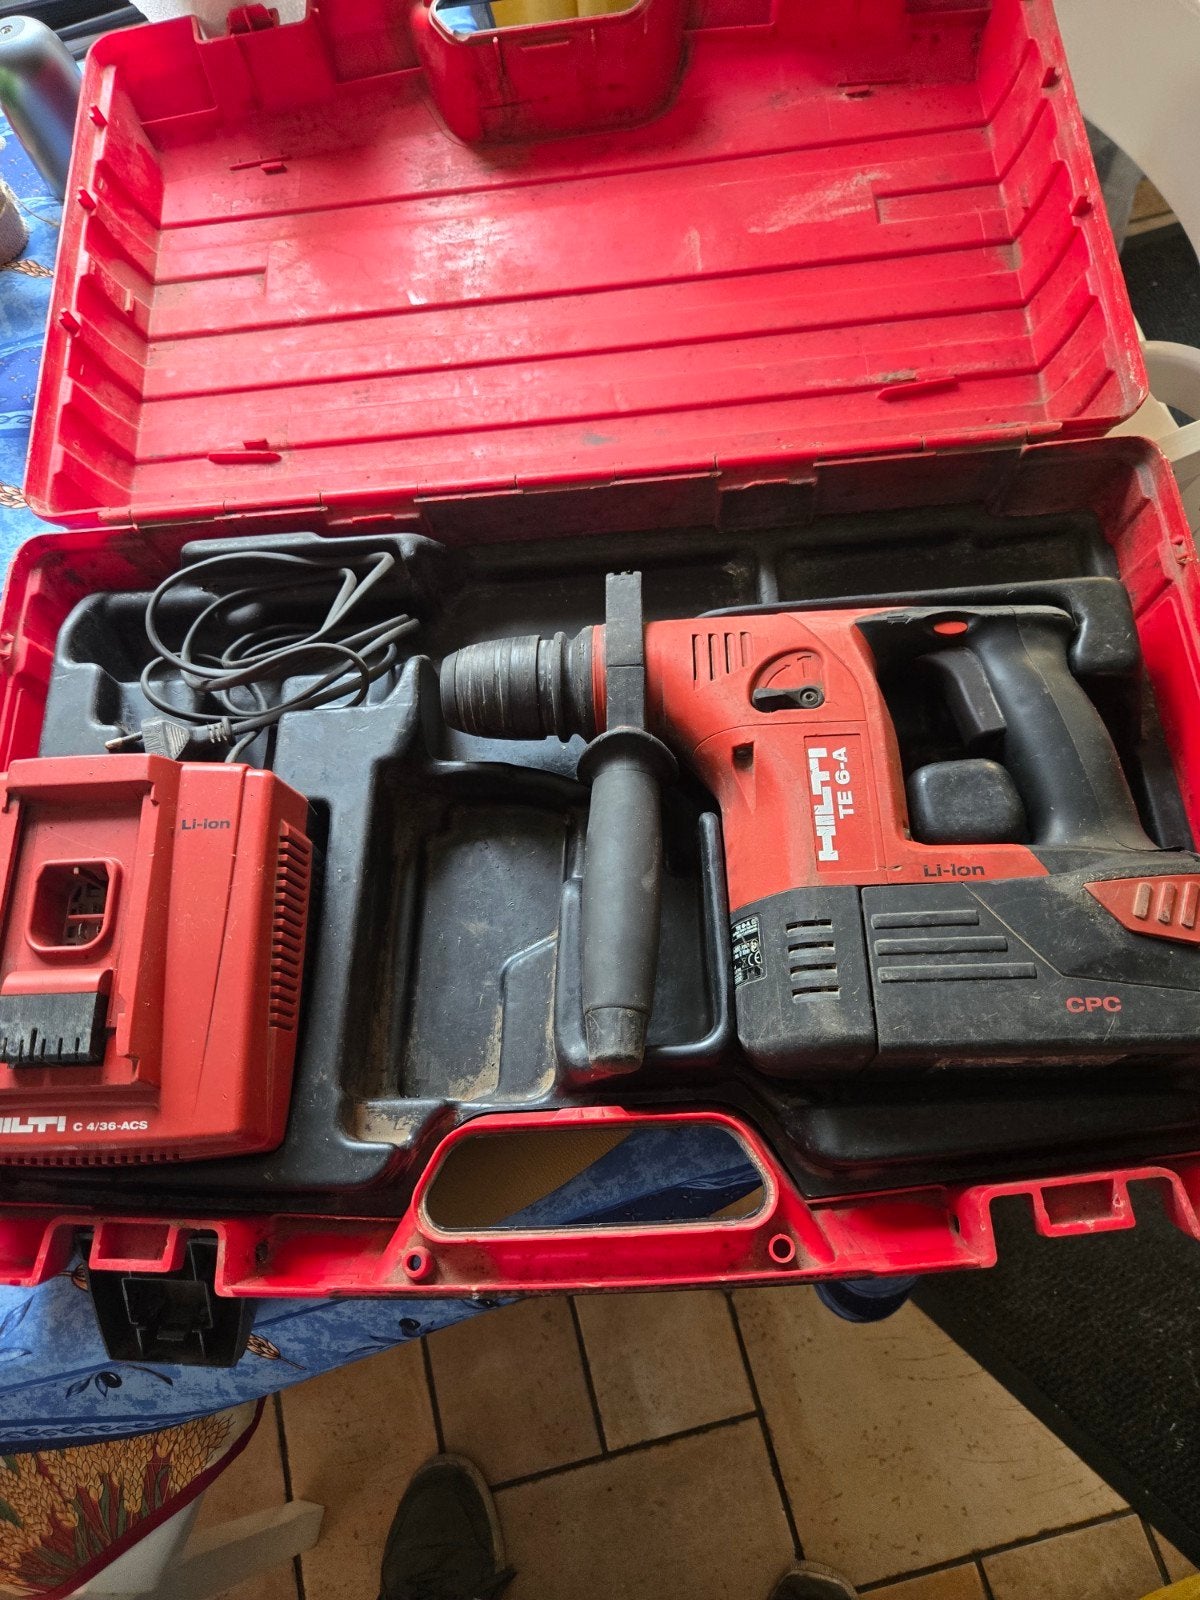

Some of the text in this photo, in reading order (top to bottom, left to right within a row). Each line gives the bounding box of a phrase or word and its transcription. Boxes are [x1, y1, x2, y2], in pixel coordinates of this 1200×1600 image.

[808, 747, 839, 861] HILTI
[832, 746, 854, 819] TE 6-A
[1065, 996, 1122, 1013] CPC
[0, 1115, 149, 1134] ILTI C 4/36-ACS
